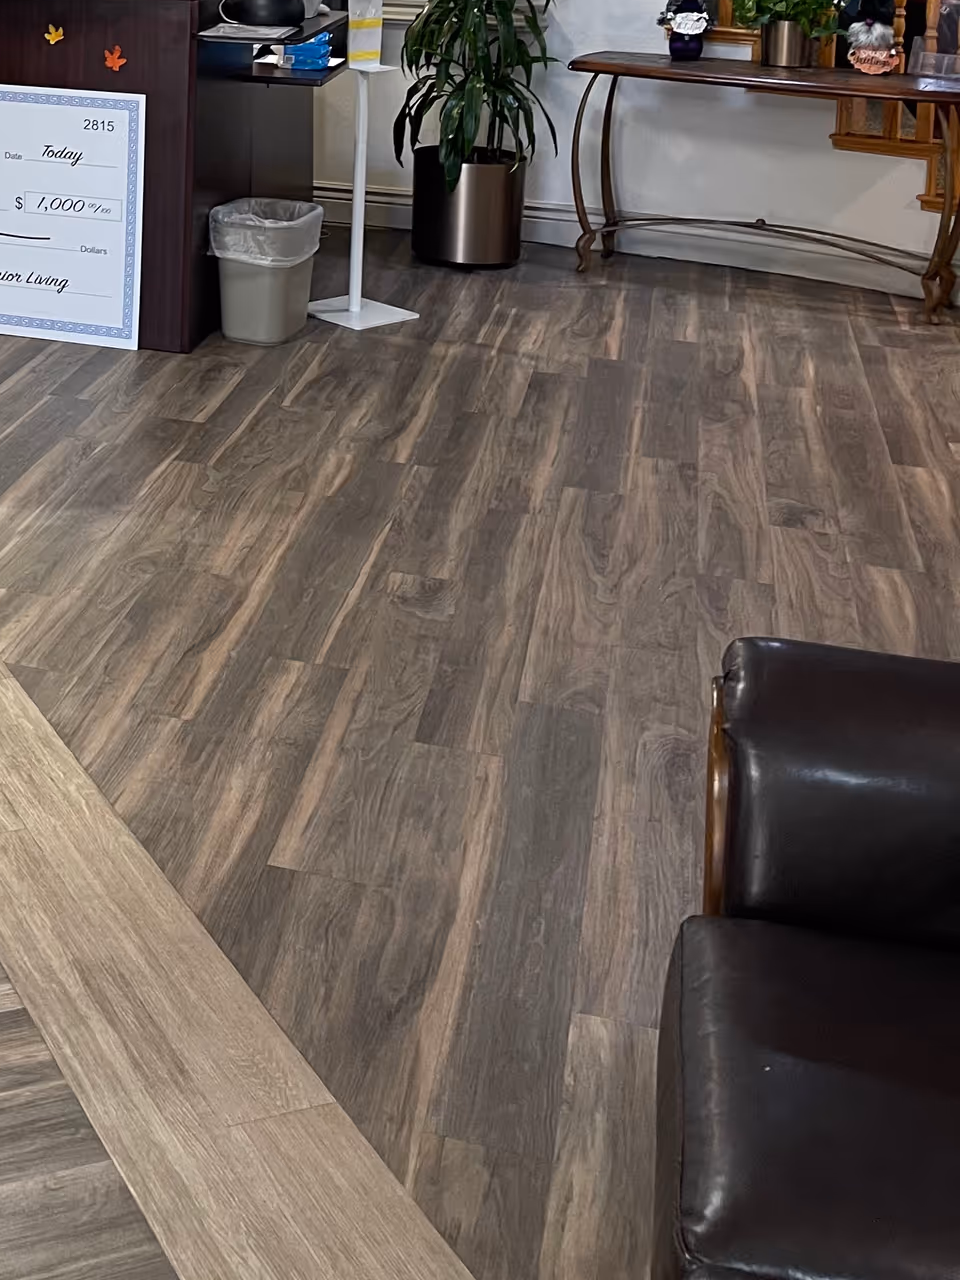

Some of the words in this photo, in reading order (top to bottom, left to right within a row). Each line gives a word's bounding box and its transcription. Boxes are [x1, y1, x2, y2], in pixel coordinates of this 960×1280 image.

[83, 118, 115, 132] 2815
[4, 151, 23, 161] Date
[42, 144, 84, 167] Today
[15, 196, 24, 210] $
[36, 196, 86, 213] 1,000
[80, 245, 108, 256] Dollars
[26, 271, 70, 294] Living
